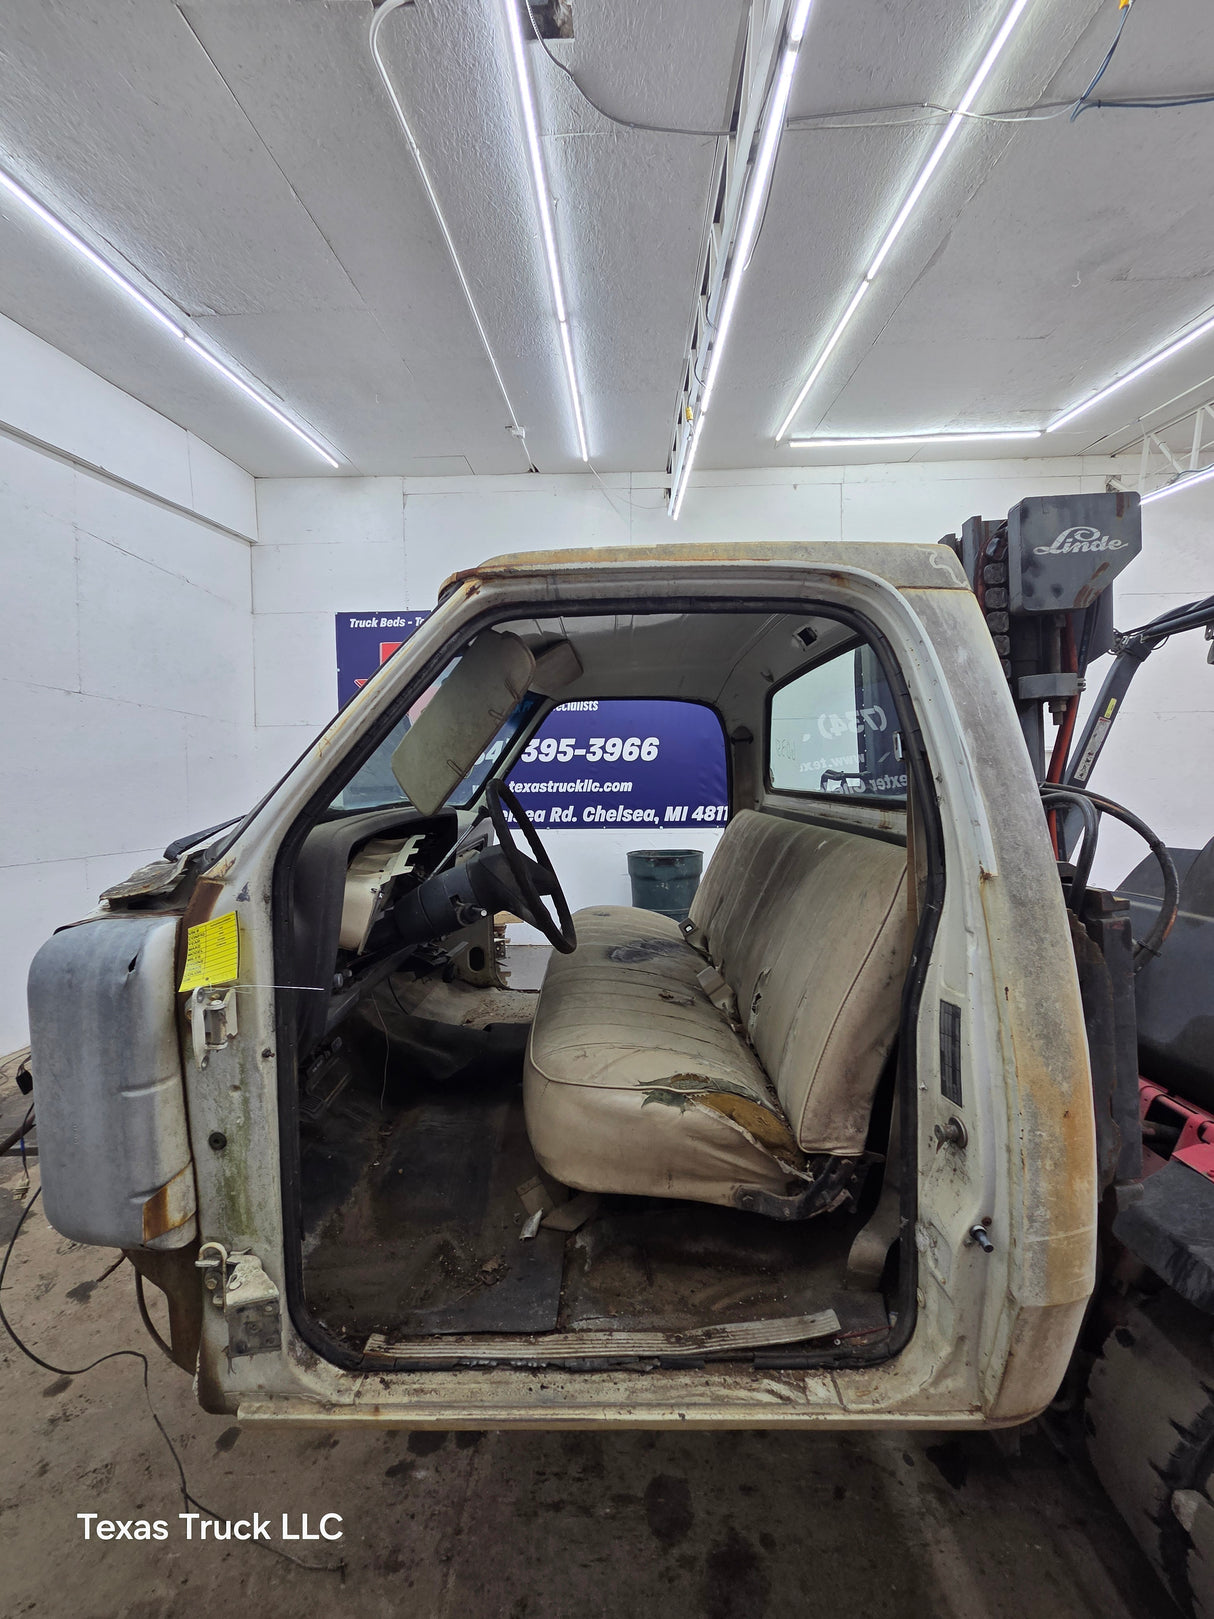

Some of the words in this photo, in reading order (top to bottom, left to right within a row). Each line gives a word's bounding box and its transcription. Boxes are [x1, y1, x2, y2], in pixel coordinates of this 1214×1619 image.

[1033, 526, 1129, 555] Linde
[349, 617, 379, 628] Truck
[380, 616, 406, 627] Beds
[553, 700, 599, 711] ecialists
[521, 736, 660, 763] 395-3966
[549, 805, 578, 822] Rd.
[582, 805, 660, 825] Chelsea,
[664, 806, 689, 822] MI
